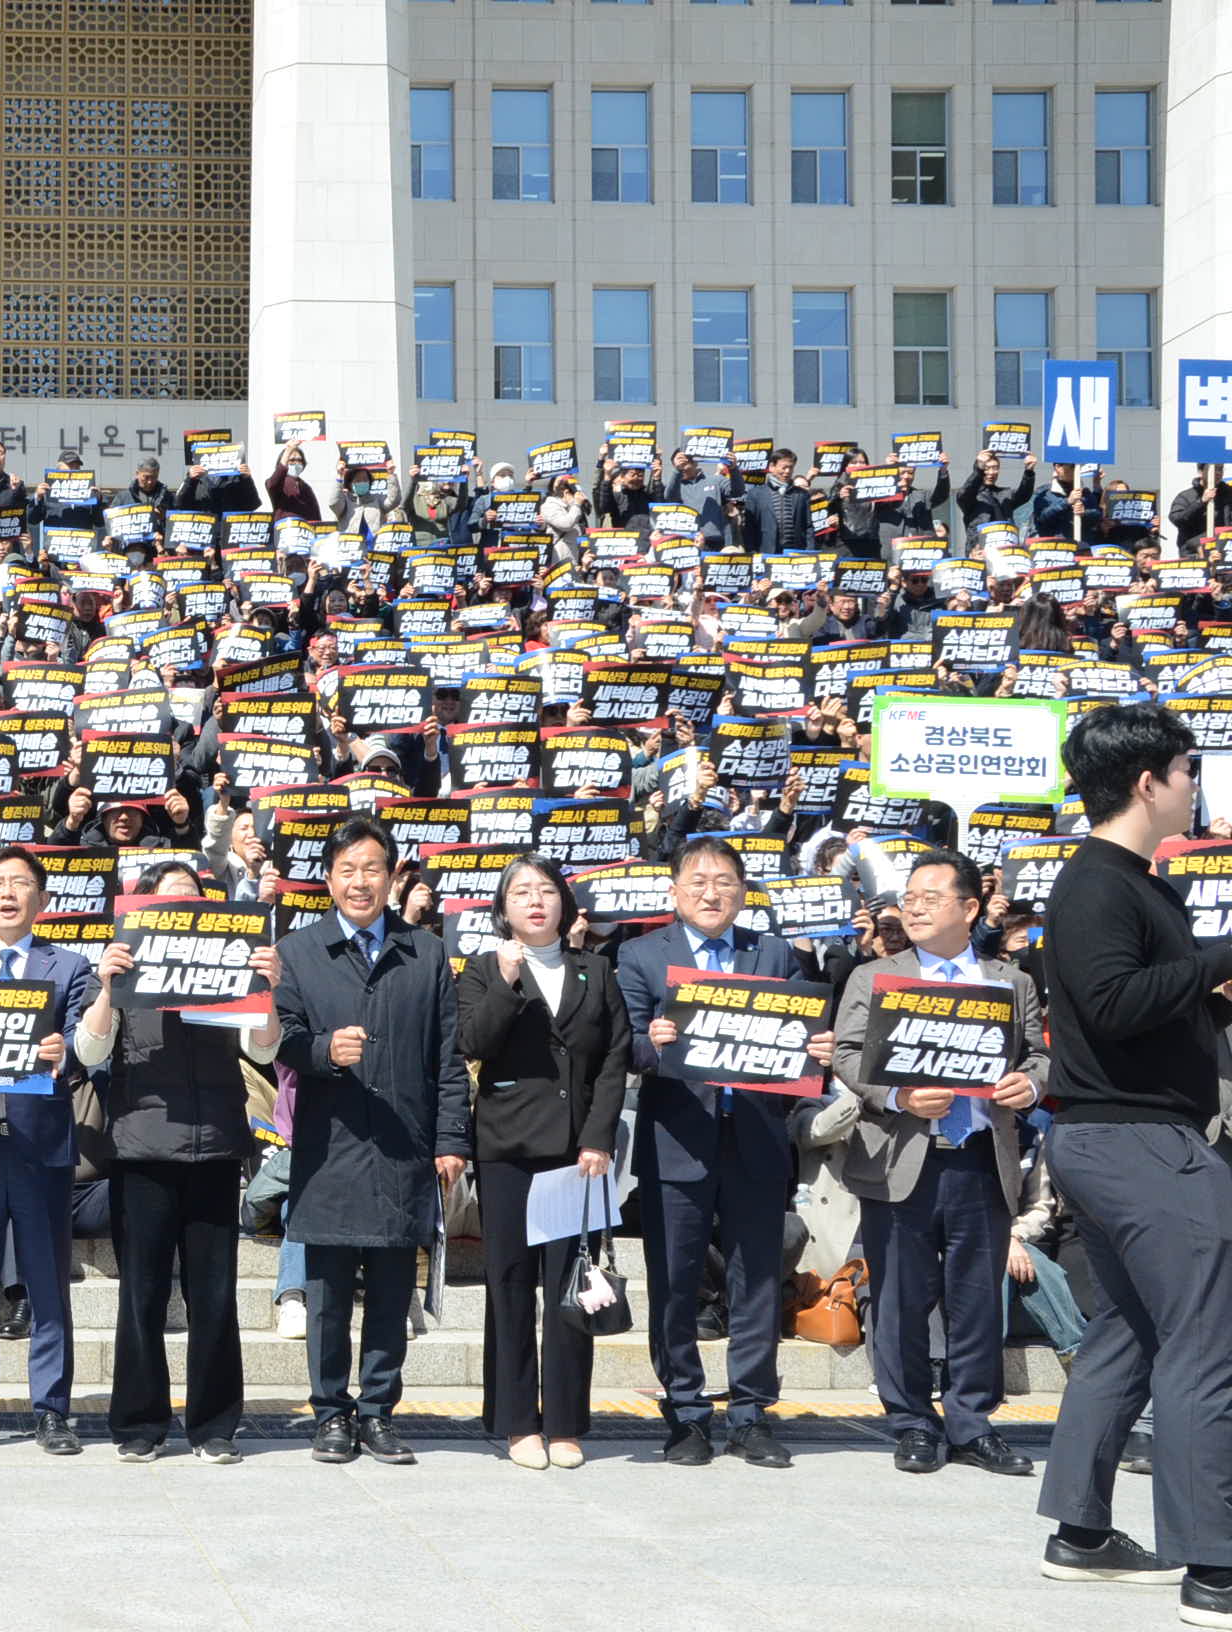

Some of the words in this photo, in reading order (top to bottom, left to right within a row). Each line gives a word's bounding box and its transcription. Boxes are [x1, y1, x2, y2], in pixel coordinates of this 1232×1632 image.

[1047, 376, 1109, 450] 새
[60, 425, 168, 456] 나온다
[936, 617, 973, 627] 대형마트
[974, 617, 1013, 628] 규제완화
[943, 628, 1008, 646] 소상공인
[940, 645, 1009, 661] 다죽는다!
[344, 675, 385, 687] 골목상권
[388, 674, 428, 687] 생존위협
[587, 671, 628, 685] 골목상권
[630, 672, 668, 685] 생존위협
[730, 664, 763, 676] 골목상권
[765, 665, 803, 678] 생존위협
[593, 685, 658, 703] 새벽배송
[737, 676, 800, 693] 새벽배송
[350, 688, 421, 707] 새벽배송
[741, 691, 805, 708] 결사반대
[352, 705, 423, 724] 결사반대
[592, 701, 658, 720] 결사반대
[888, 710, 927, 721] KFME
[453, 732, 494, 745] 골목상권
[495, 731, 535, 744] 생존위협
[546, 737, 586, 750] 골목상권
[588, 738, 626, 752] 생존위협
[924, 726, 1013, 747] 경상북도
[86, 739, 130, 753] 골목상권
[133, 741, 170, 756] 생존위협
[461, 745, 528, 765] 새벽배송
[722, 739, 788, 759] 소상공인
[92, 757, 166, 775] 새벽배송
[551, 751, 621, 769] 새벽배송
[889, 753, 1047, 777] 소상공인연합회
[463, 763, 529, 782] 결사반대
[554, 767, 620, 788] 결사반대
[93, 774, 168, 795] 결사반대
[549, 810, 584, 824] 과로사
[585, 809, 619, 822] 유발법!
[539, 826, 584, 843] 유통법
[586, 825, 627, 842] 개정안
[538, 844, 567, 860] 즉각
[569, 843, 630, 860] 철회하라!
[123, 911, 193, 931] 골목상권
[196, 912, 265, 934] 생존위협
[133, 935, 251, 967] 새벽배송
[135, 966, 254, 996] 결사반대
[675, 984, 748, 1007] 골목상권
[753, 992, 826, 1017] 생존위협
[879, 991, 954, 1015] 골목상권
[955, 998, 1011, 1022] 생존위협
[684, 1010, 809, 1048] 새벽배송
[887, 1017, 1006, 1055] 새벽배송
[684, 1038, 809, 1080] 결사반대
[884, 1047, 1007, 1084] 결사반대
